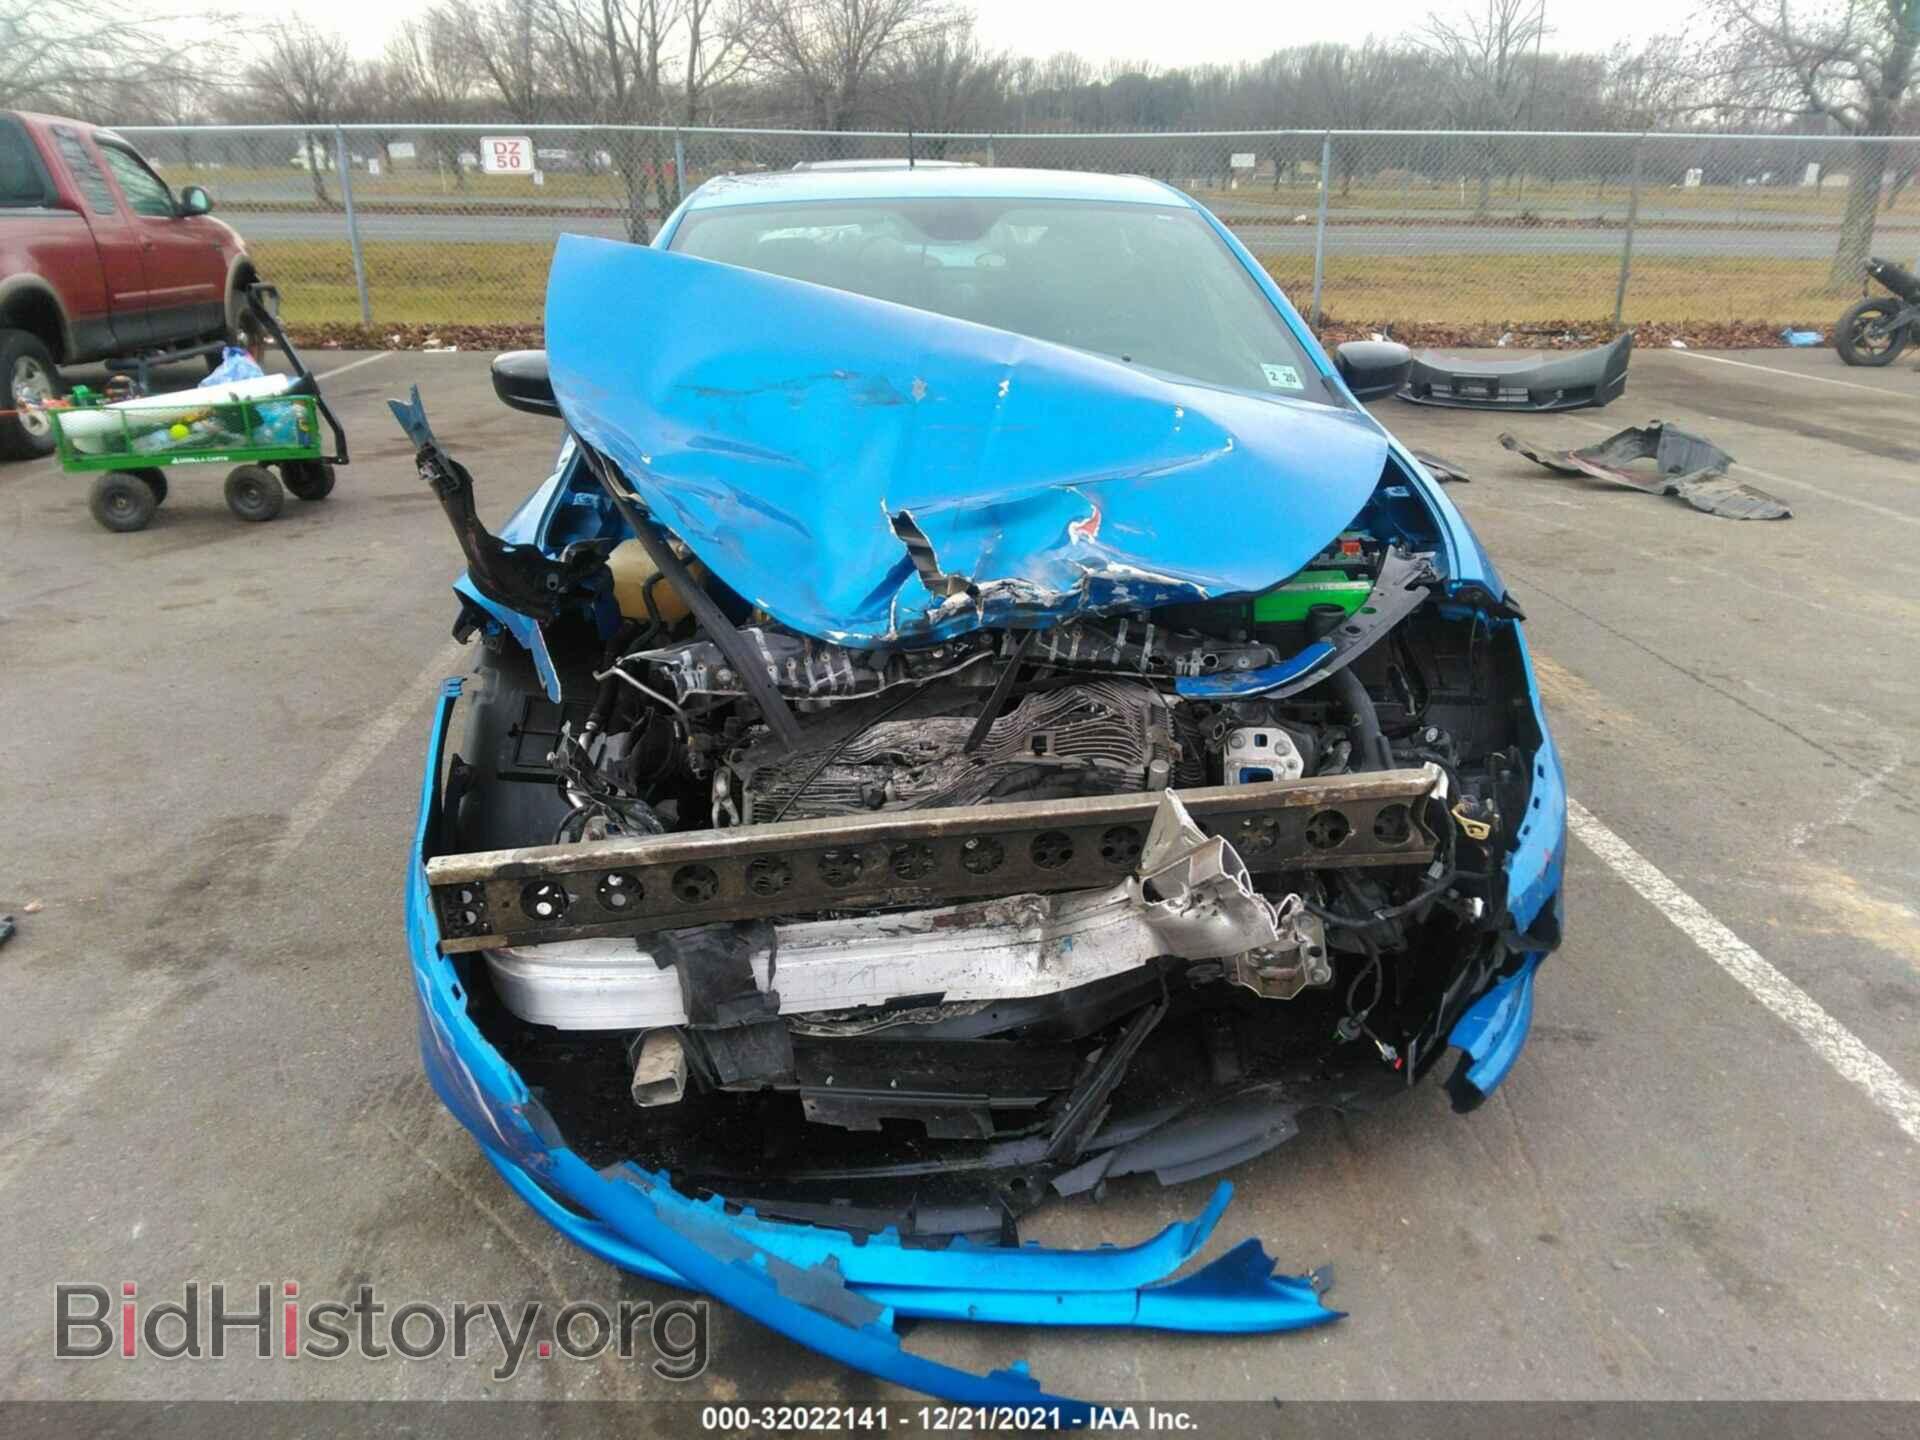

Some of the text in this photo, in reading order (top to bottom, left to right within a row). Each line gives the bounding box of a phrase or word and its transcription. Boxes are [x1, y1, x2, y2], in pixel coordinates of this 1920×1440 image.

[494, 142, 521, 155] DZ
[496, 155, 520, 169] 50
[1269, 371, 1280, 381] 2
